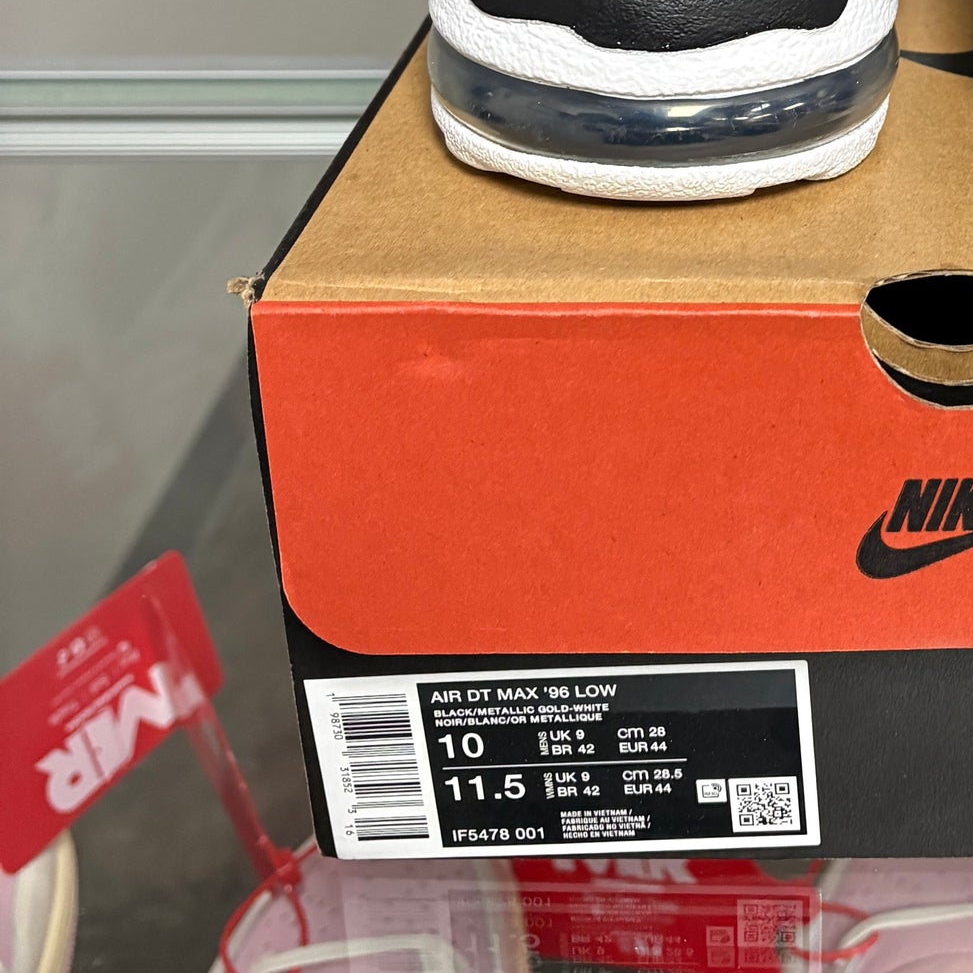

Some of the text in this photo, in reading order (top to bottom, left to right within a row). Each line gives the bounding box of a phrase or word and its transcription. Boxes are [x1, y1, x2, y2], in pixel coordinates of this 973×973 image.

[431, 683, 617, 704] AIR DT MAX '96 LOW
[433, 702, 610, 718] BLACK/METALLIC GOLD-WHITE
[435, 712, 603, 728] NOIR/BLANC/OR METALLIQUE
[550, 729, 585, 742] UK 9
[617, 726, 667, 740] cm 28
[438, 732, 485, 759] 10
[537, 731, 550, 756] MENS
[551, 743, 596, 755] BR 42
[618, 741, 668, 754] EUR 44
[330, 712, 344, 741] 98730
[340, 766, 354, 794] 31852
[555, 771, 591, 783] UK 9
[622, 768, 683, 781] cm 28.5
[444, 773, 526, 801] 11.5
[557, 785, 601, 797] BR 42
[623, 783, 672, 795] EUR 44
[560, 810, 583, 818] MADE
[593, 809, 628, 817] VIETNAM
[561, 817, 599, 825] FABRIQUE
[600, 816, 610, 824] AU
[611, 815, 646, 823] VIETNAM
[562, 824, 605, 832] FABRICADO
[606, 823, 617, 831] NO
[563, 829, 636, 839] HECHO EN VIETNAM
[452, 827, 545, 842] IF5478 001
